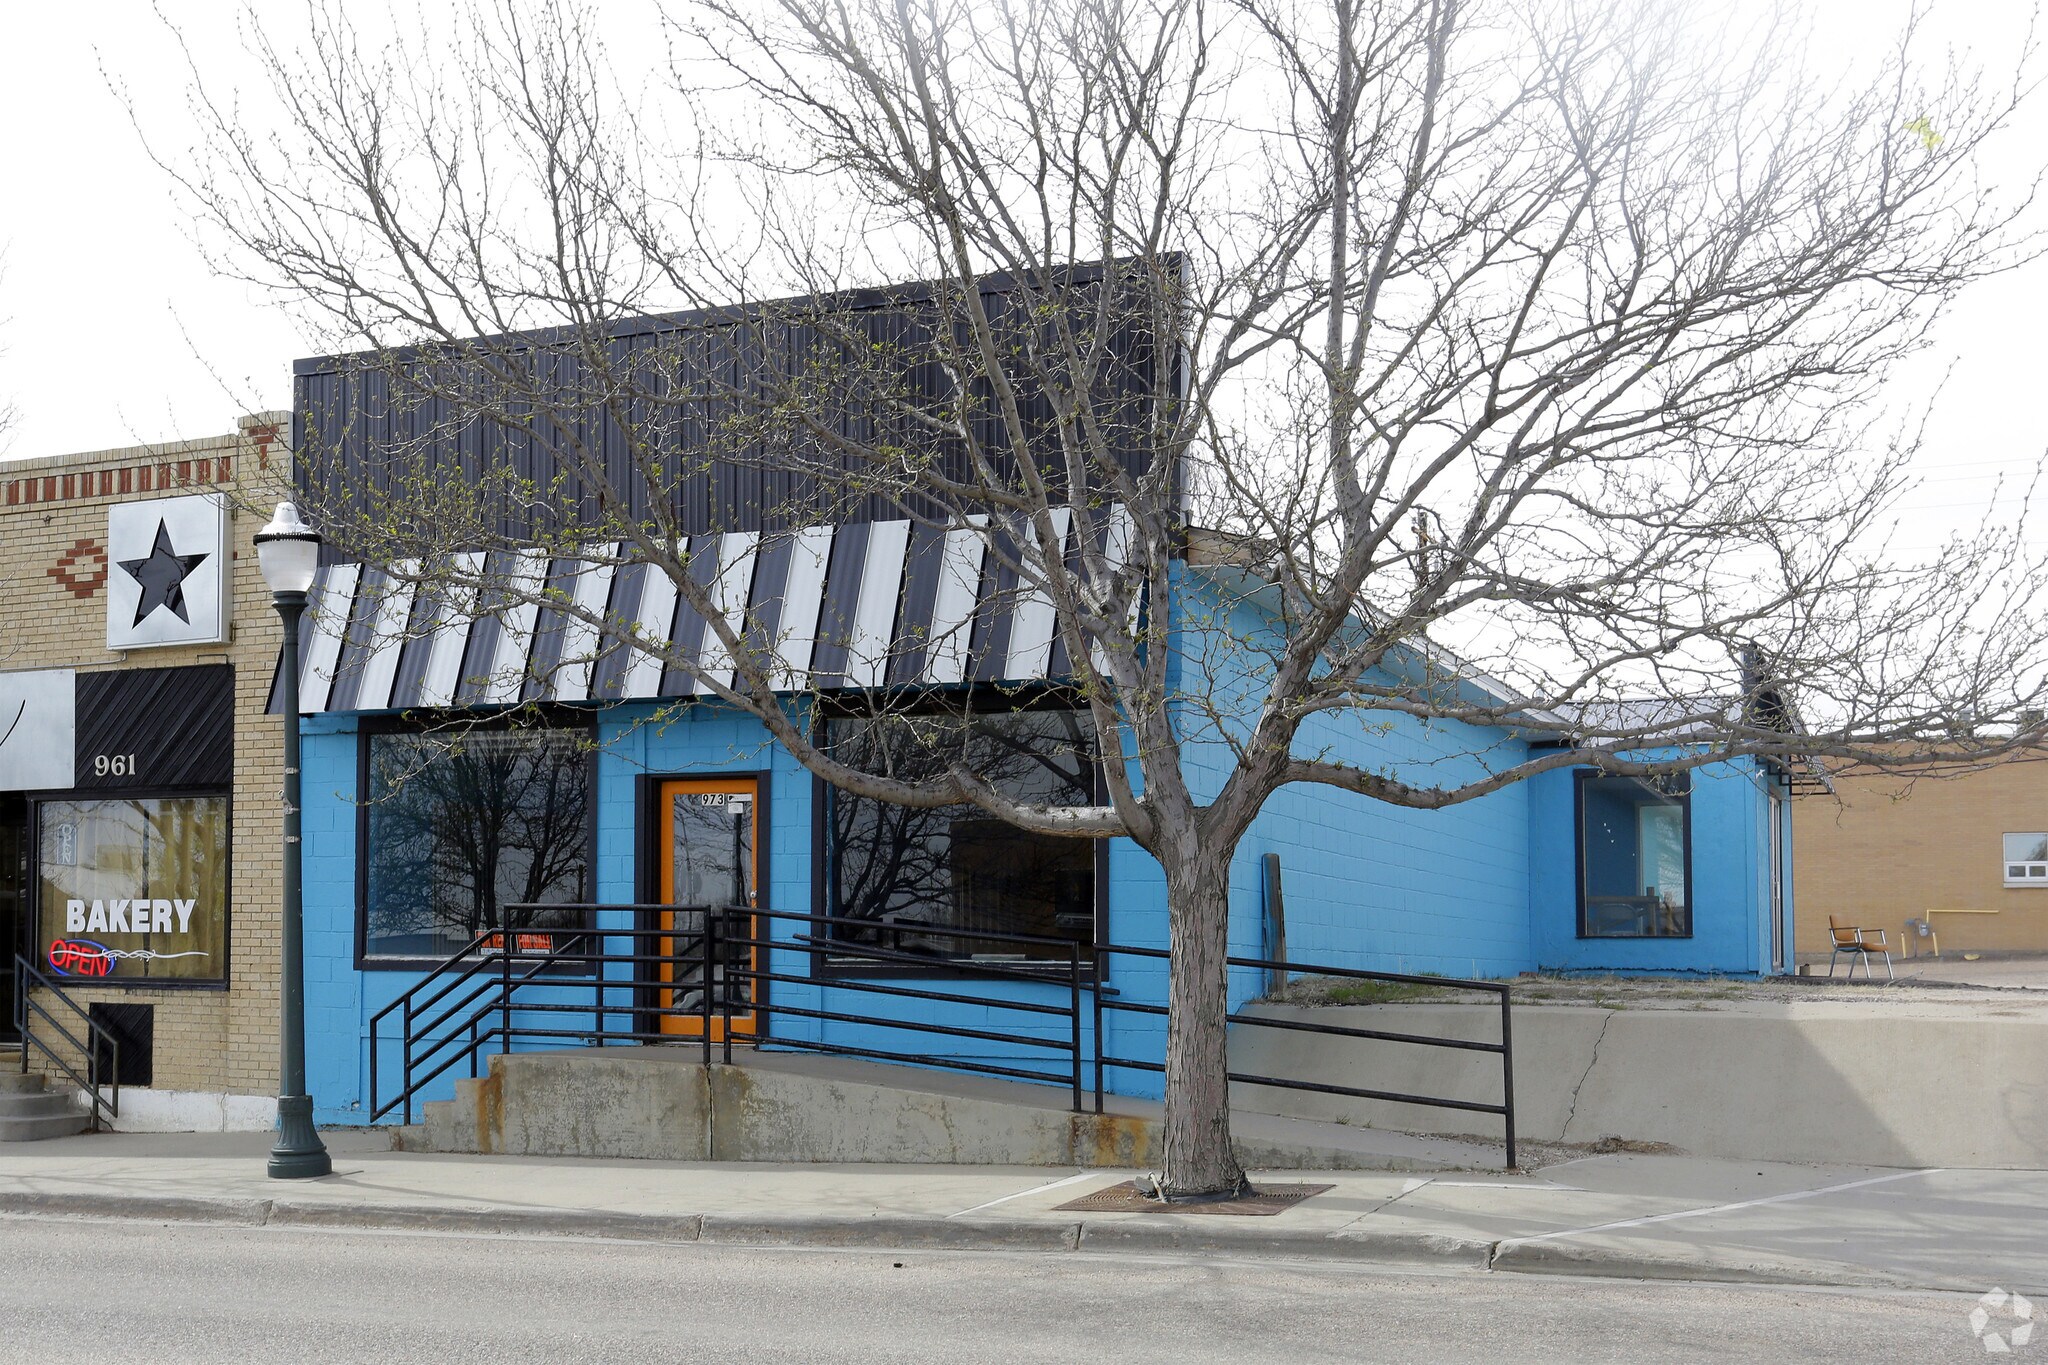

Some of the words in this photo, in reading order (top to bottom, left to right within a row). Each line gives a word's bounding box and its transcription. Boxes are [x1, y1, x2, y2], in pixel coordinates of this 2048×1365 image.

[95, 753, 135, 776] 961
[703, 794, 724, 805] 973
[66, 899, 196, 933] BAKERY
[518, 934, 532, 949] FOR
[532, 934, 551, 949] SALE
[50, 939, 108, 976] OPEN
